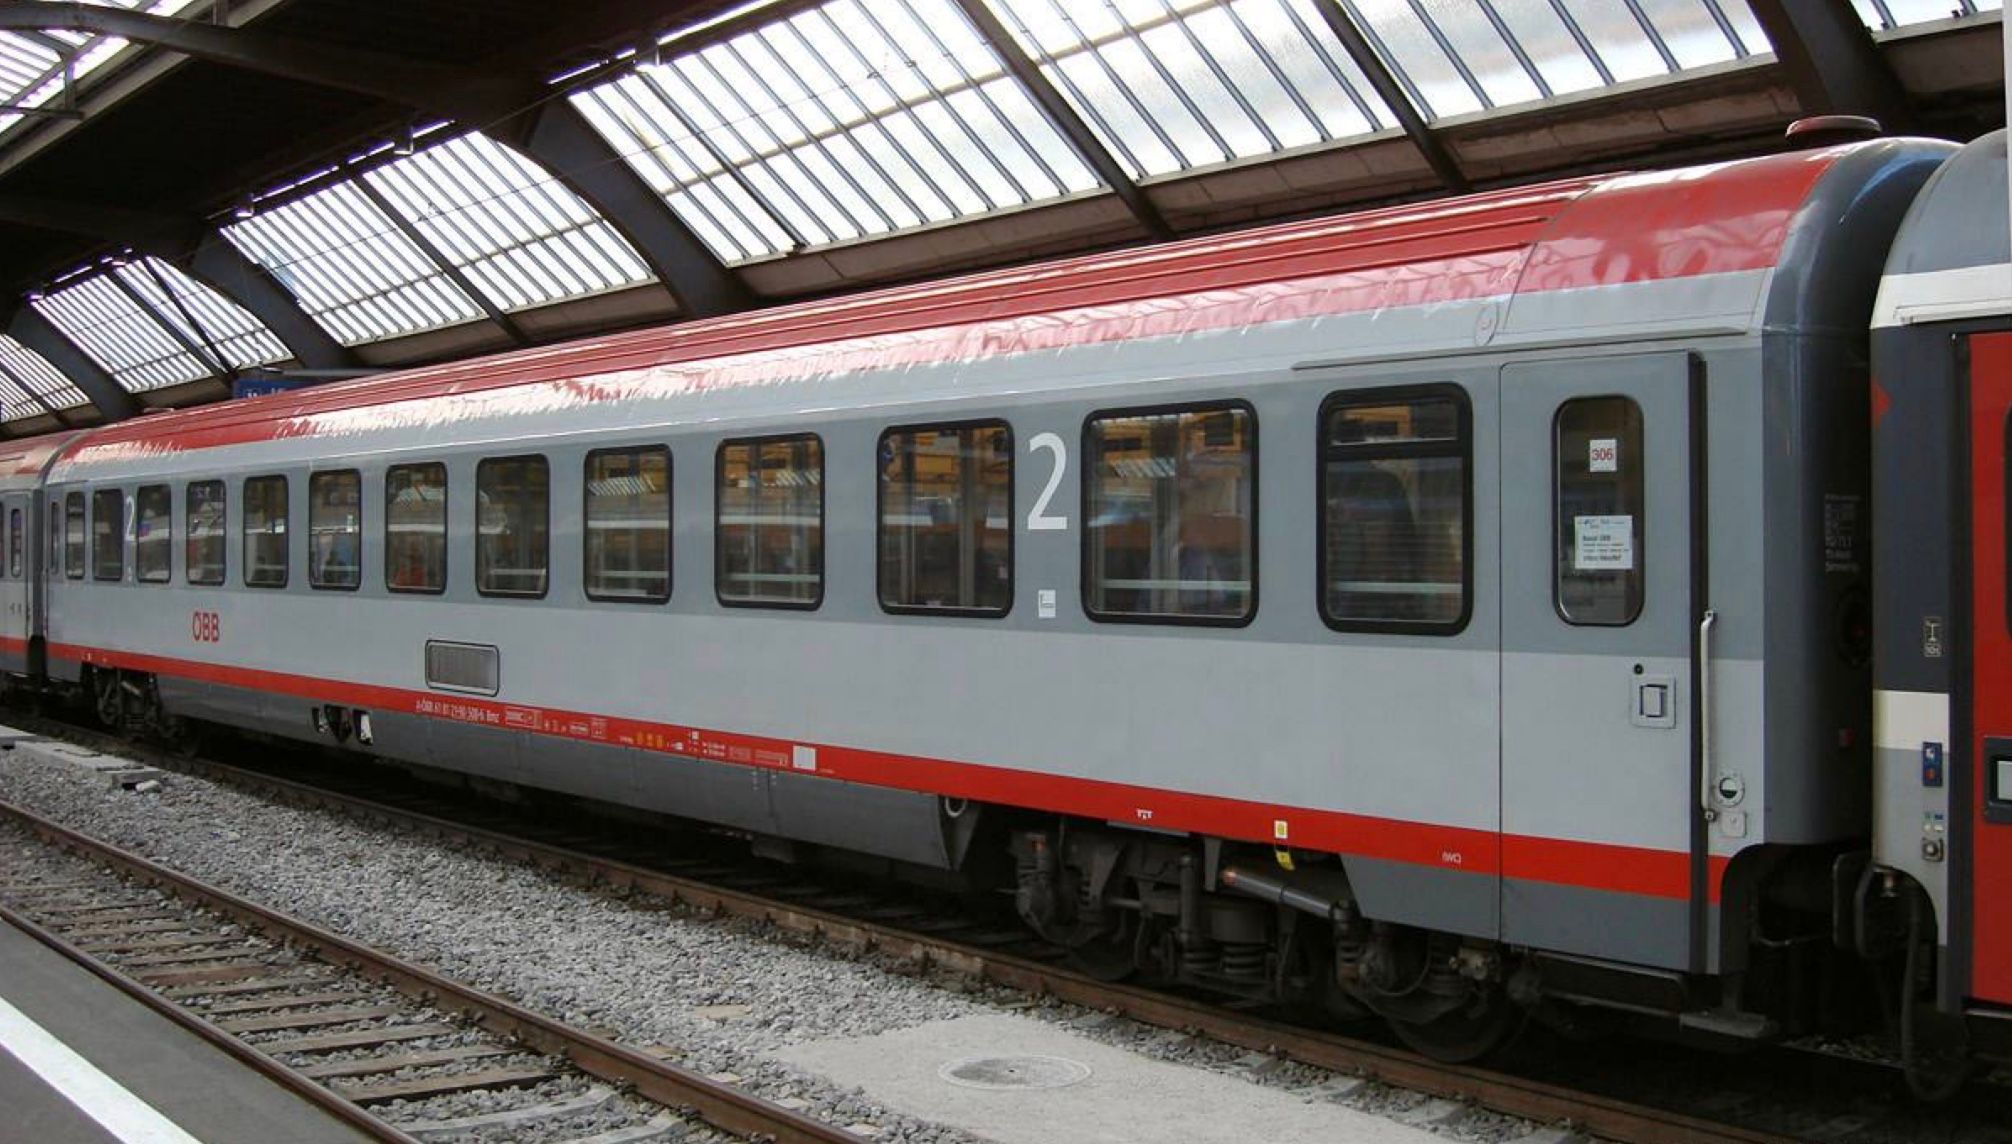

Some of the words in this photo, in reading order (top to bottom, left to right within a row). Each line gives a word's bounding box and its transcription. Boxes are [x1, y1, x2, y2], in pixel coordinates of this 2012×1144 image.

[1592, 448, 1613, 461] 306
[1028, 432, 1067, 529] 2
[125, 496, 136, 542] 2
